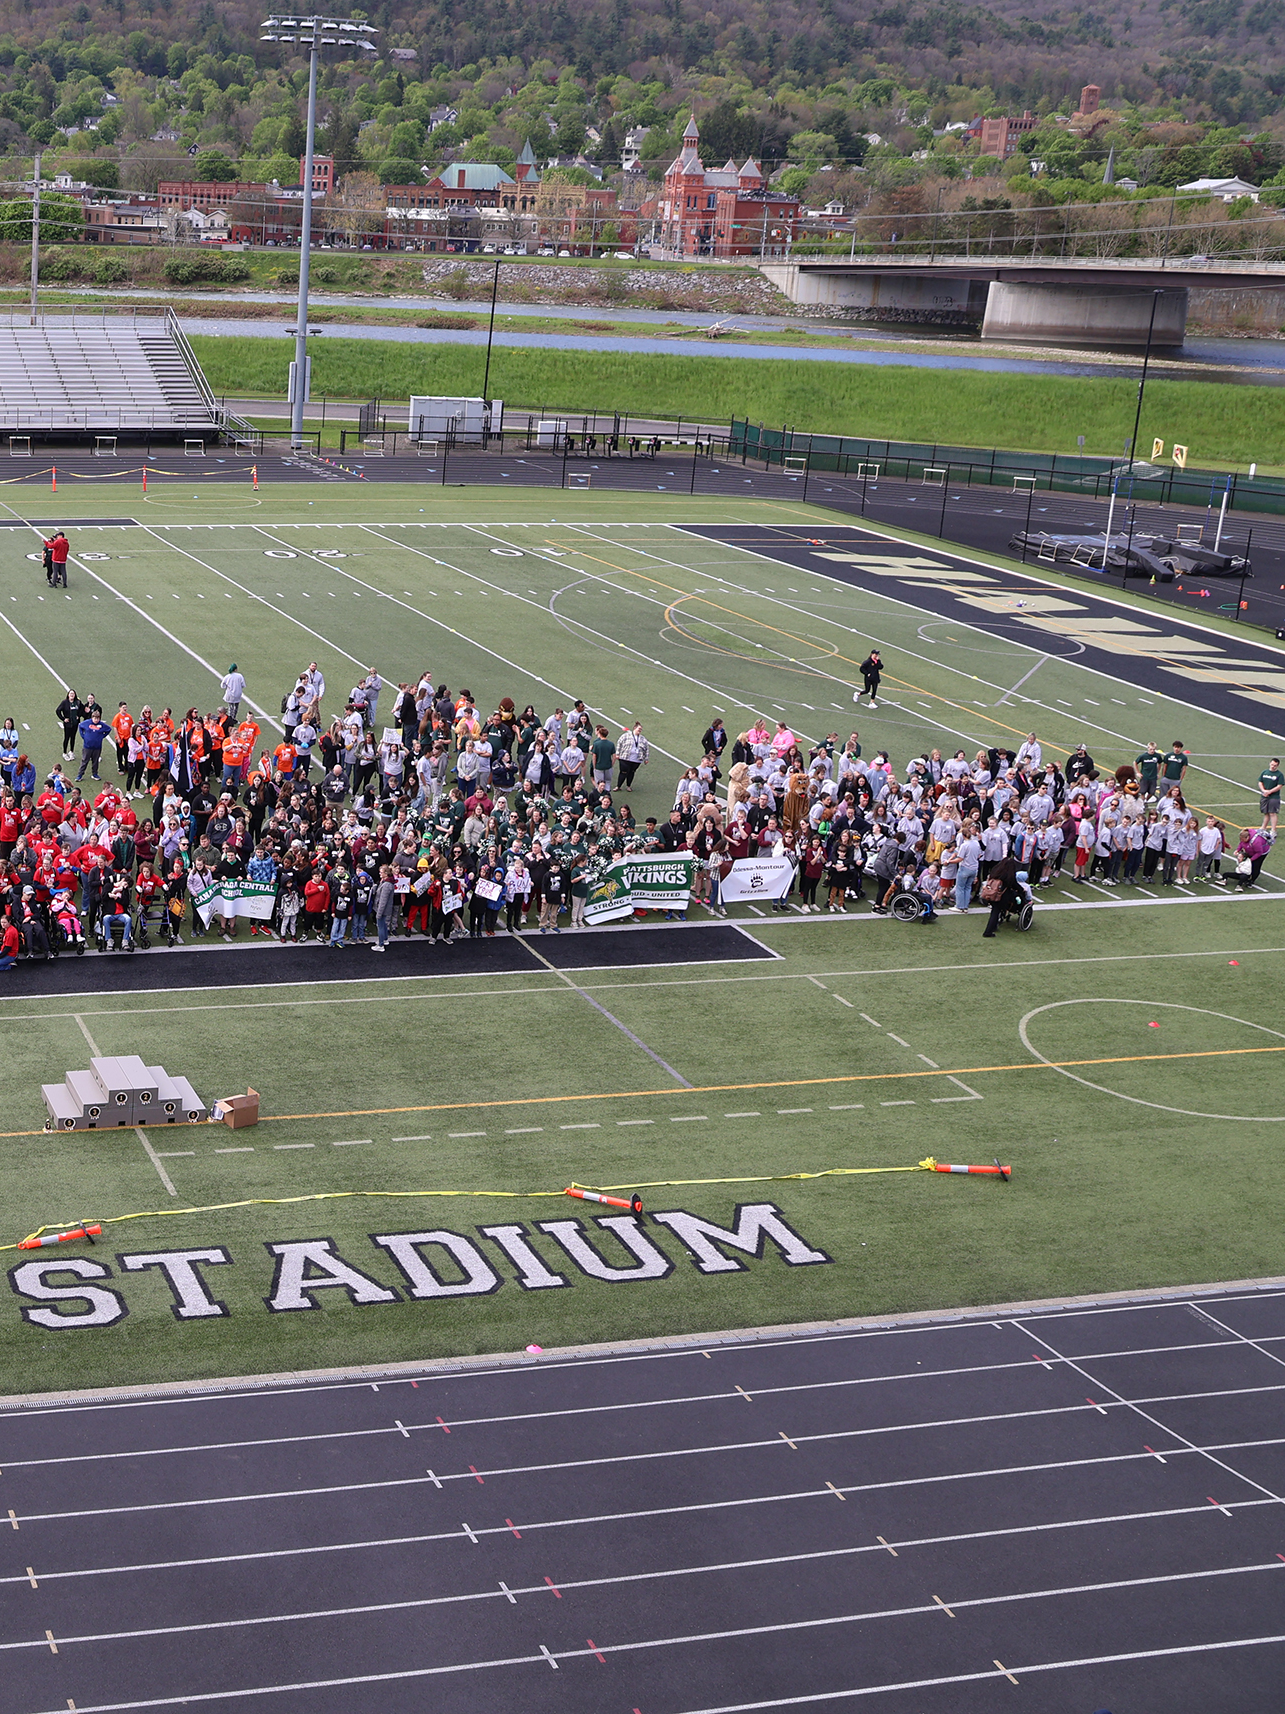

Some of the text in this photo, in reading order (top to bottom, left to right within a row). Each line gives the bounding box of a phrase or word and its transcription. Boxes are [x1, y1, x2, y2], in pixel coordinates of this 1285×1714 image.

[623, 863, 685, 875] PATTSBURGH
[621, 870, 687, 890] VIKINGS
[239, 882, 275, 893] CENTRAL
[593, 899, 625, 910] STRONG
[7, 1200, 834, 1333] STADIUM
